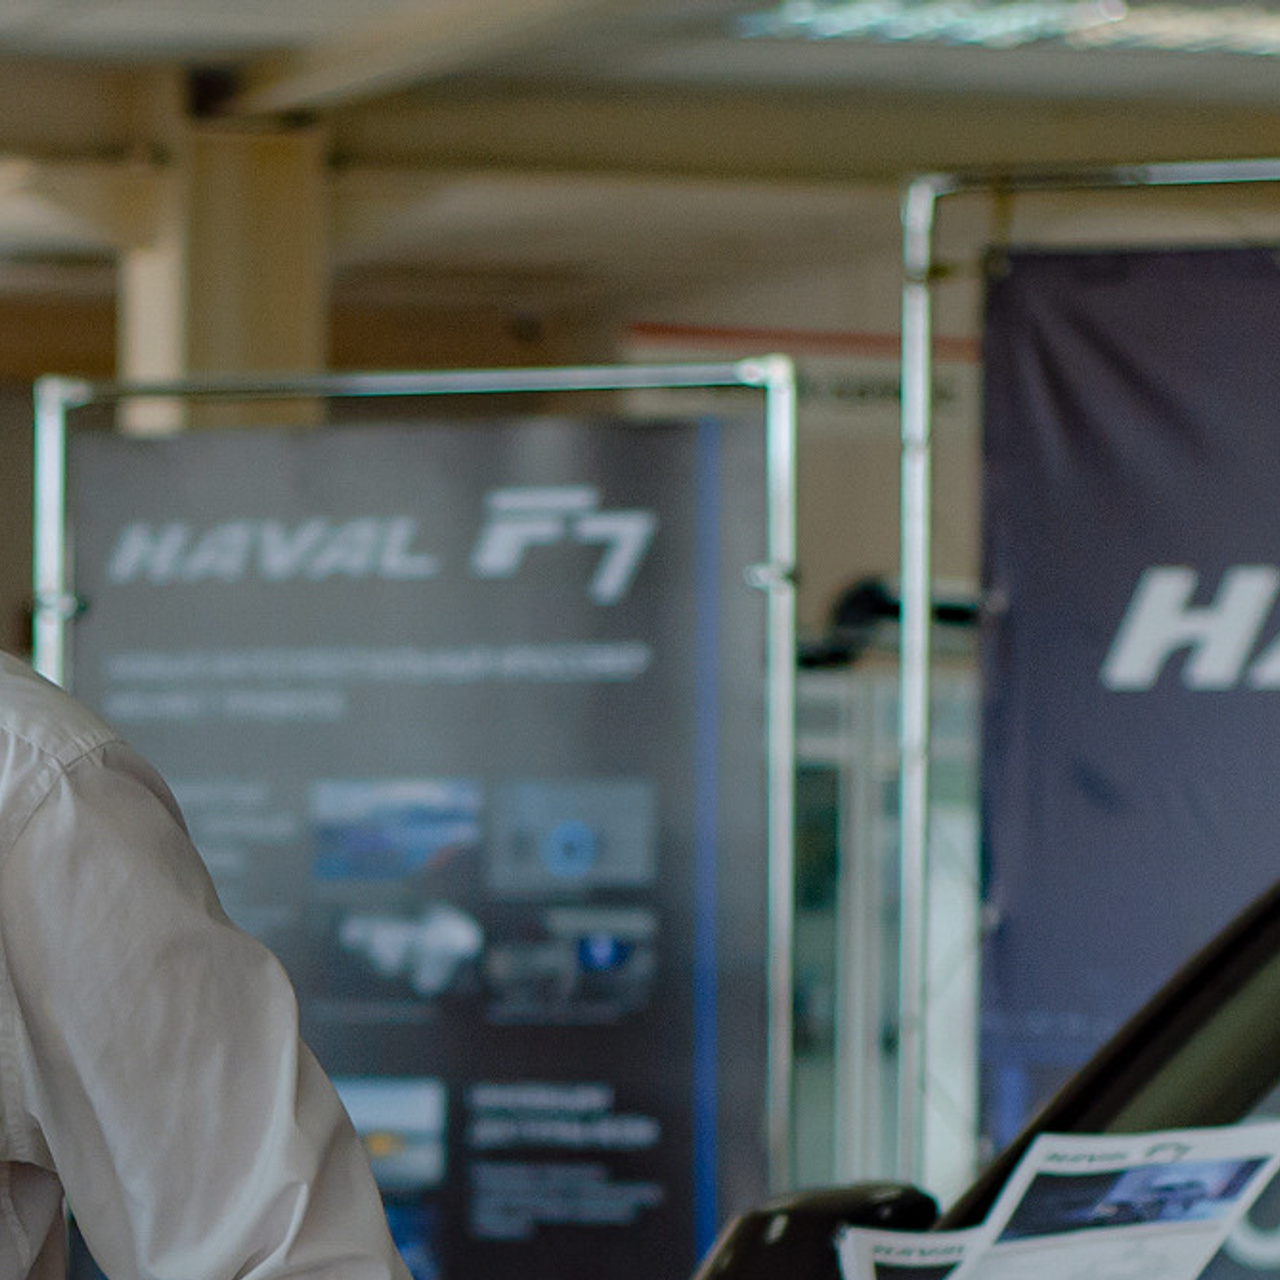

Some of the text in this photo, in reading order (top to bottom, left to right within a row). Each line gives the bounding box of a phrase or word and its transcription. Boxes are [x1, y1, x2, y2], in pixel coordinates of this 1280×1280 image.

[110, 486, 656, 605] HAVAL F7
[1099, 564, 1280, 692] H
